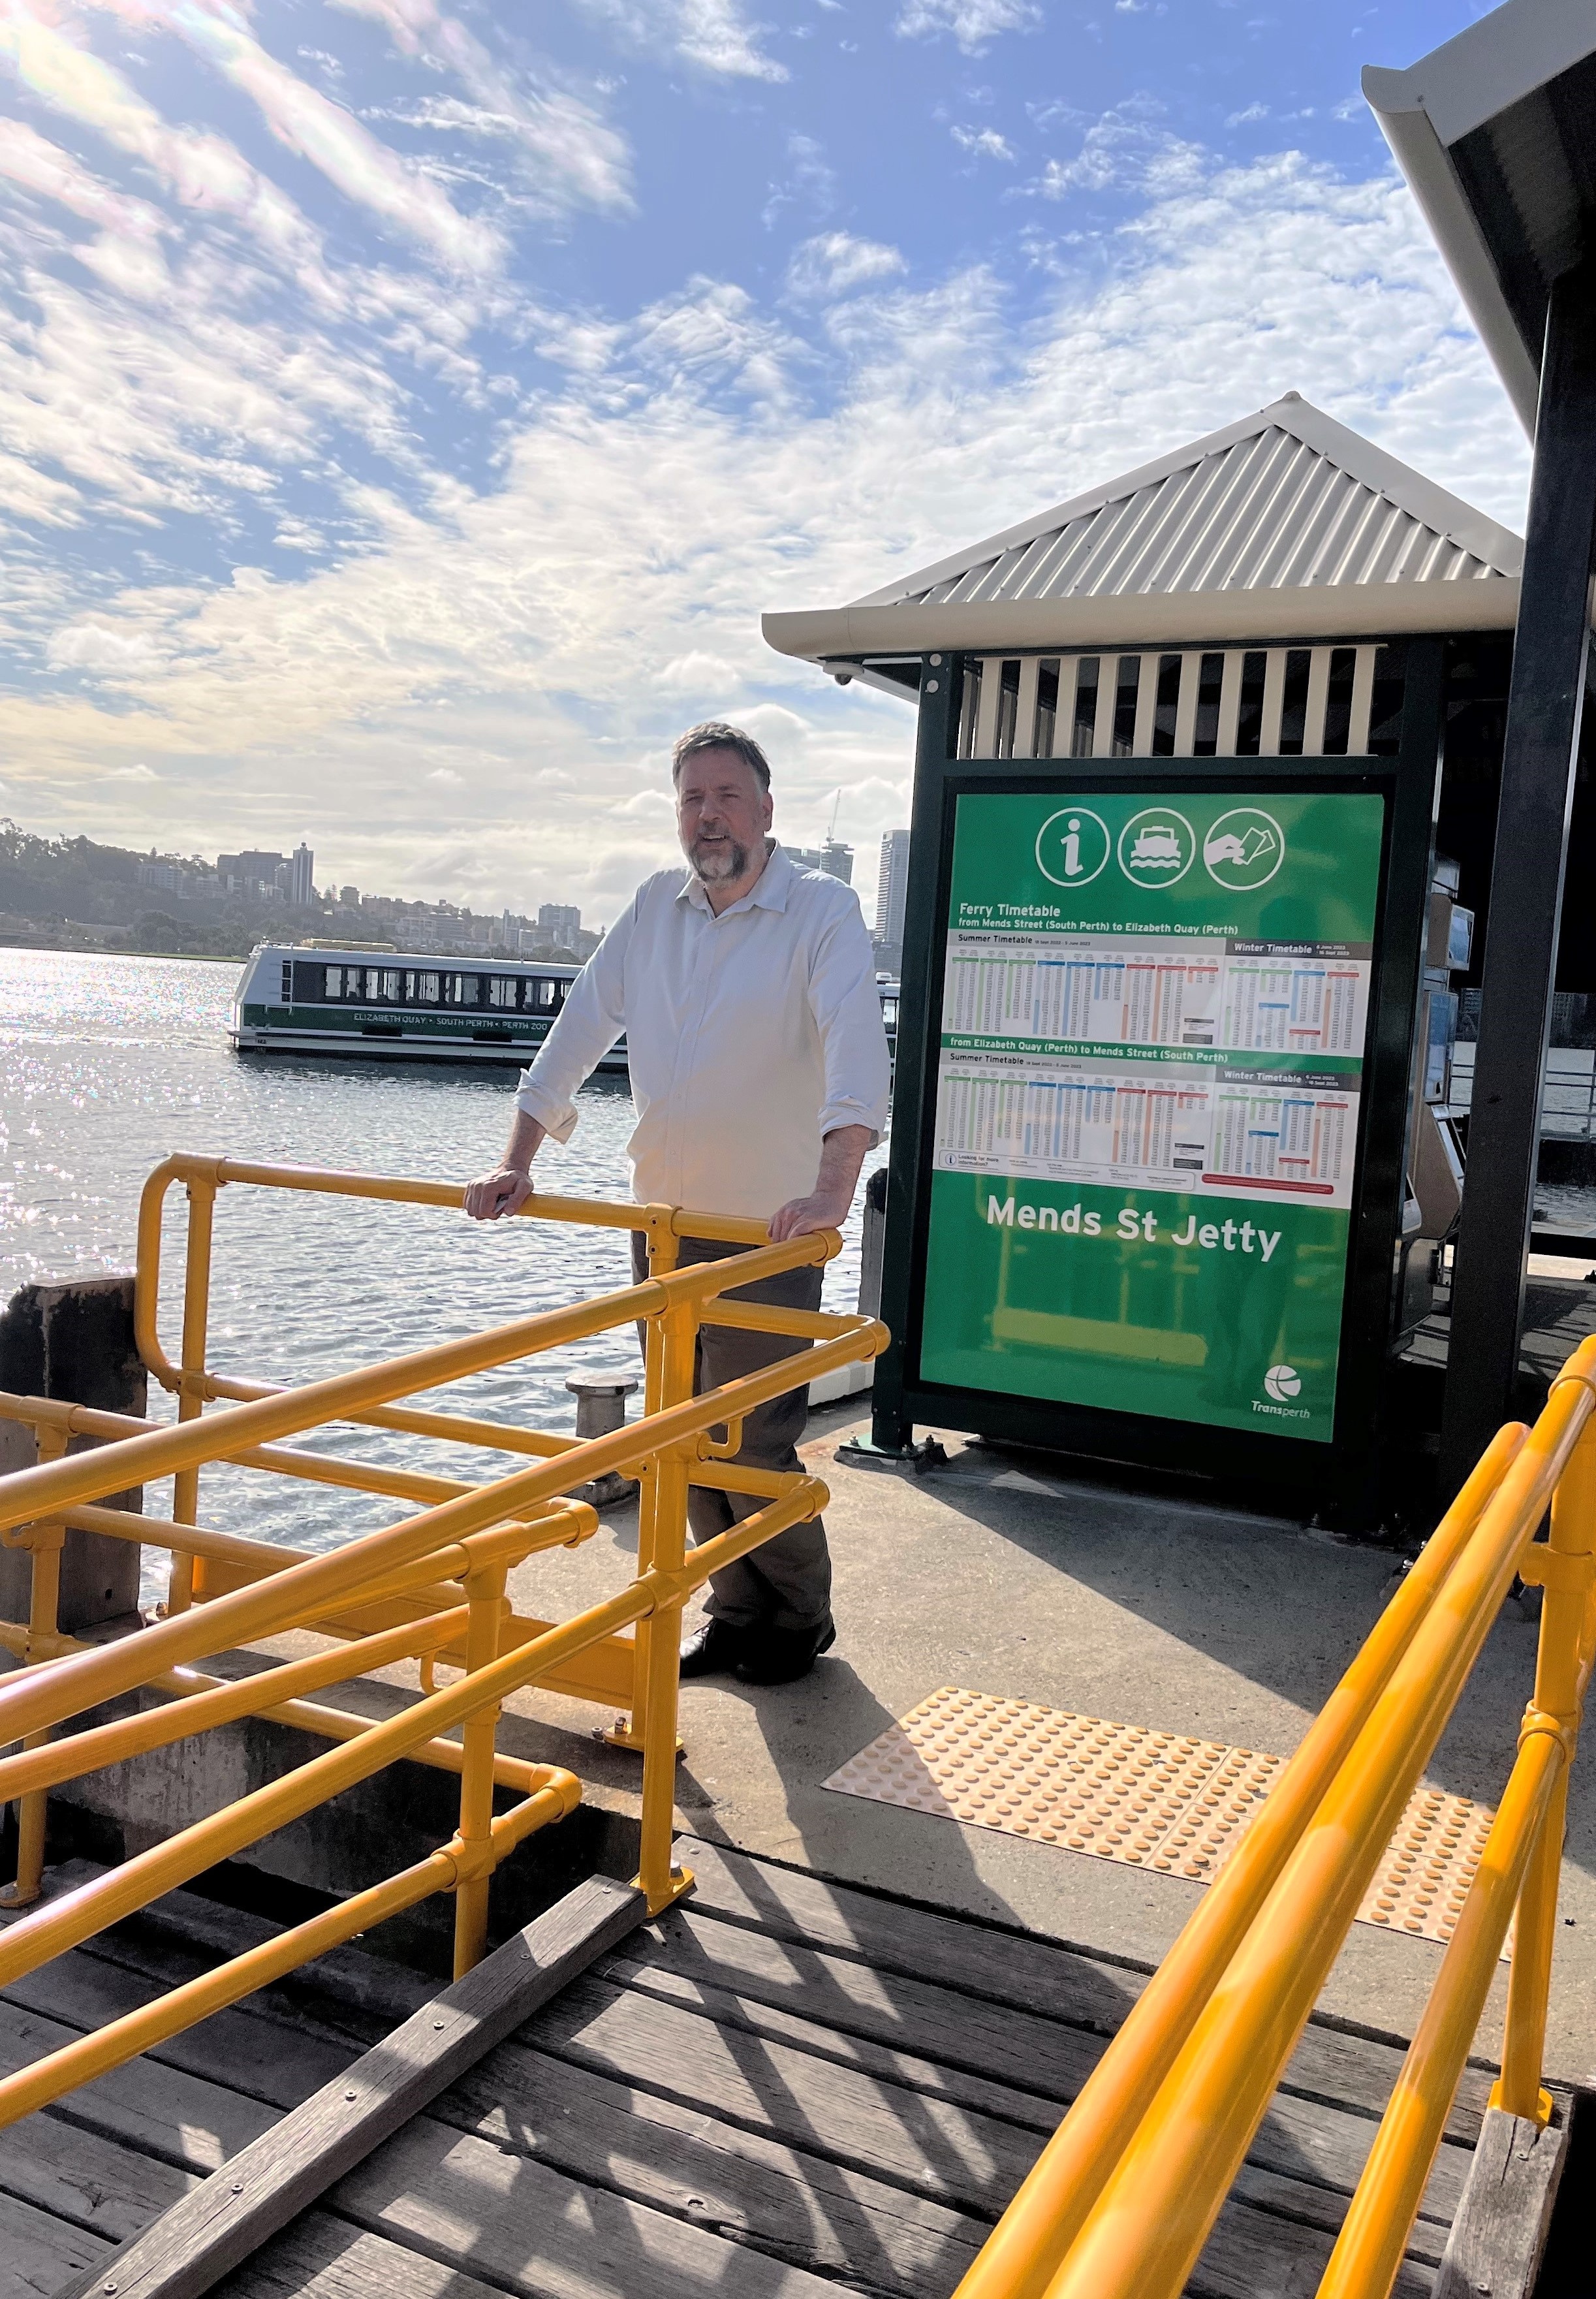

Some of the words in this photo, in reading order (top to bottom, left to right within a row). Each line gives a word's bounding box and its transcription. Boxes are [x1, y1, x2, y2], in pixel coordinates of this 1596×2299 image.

[960, 903, 993, 917] Ferry
[997, 904, 1061, 917] Timetable
[958, 917, 979, 927] from
[982, 919, 1010, 928] Mends
[1014, 919, 1042, 928] Street
[1046, 920, 1076, 930] (South
[1080, 921, 1109, 931] Perth)
[1113, 923, 1122, 931] to
[1125, 923, 1171, 932] Elizabeth
[1174, 924, 1199, 935] Quay
[1202, 925, 1238, 935] (Perth)
[958, 934, 990, 942] Summer
[994, 935, 1032, 943] Timetable
[1234, 943, 1263, 952] Winter
[1266, 944, 1312, 954] Timetable
[354, 1013, 401, 1023] ELIZABETH
[402, 1015, 426, 1024] QUAY
[437, 1017, 463, 1026] SOUTH
[465, 1019, 493, 1028] PERTH
[950, 1038, 971, 1047] from
[974, 1039, 1016, 1049] Elizabeth
[1018, 1041, 1042, 1053] Quay
[1044, 1043, 1078, 1054] (Perth)
[1080, 1045, 1089, 1054] to
[1093, 1046, 1123, 1056] Mends
[1127, 1048, 1157, 1058] Street
[1160, 1049, 1193, 1061] (South
[1196, 1052, 1228, 1063] Perth)
[950, 1053, 982, 1062] Summer
[985, 1055, 1024, 1064] Timetable
[1224, 1071, 1254, 1080] Winter
[1257, 1072, 1302, 1083] Timetable
[987, 1195, 1101, 1236] Mends
[1116, 1208, 1157, 1242] St
[1171, 1216, 1281, 1262] Jetty
[1251, 1400, 1310, 1419] Transperth
